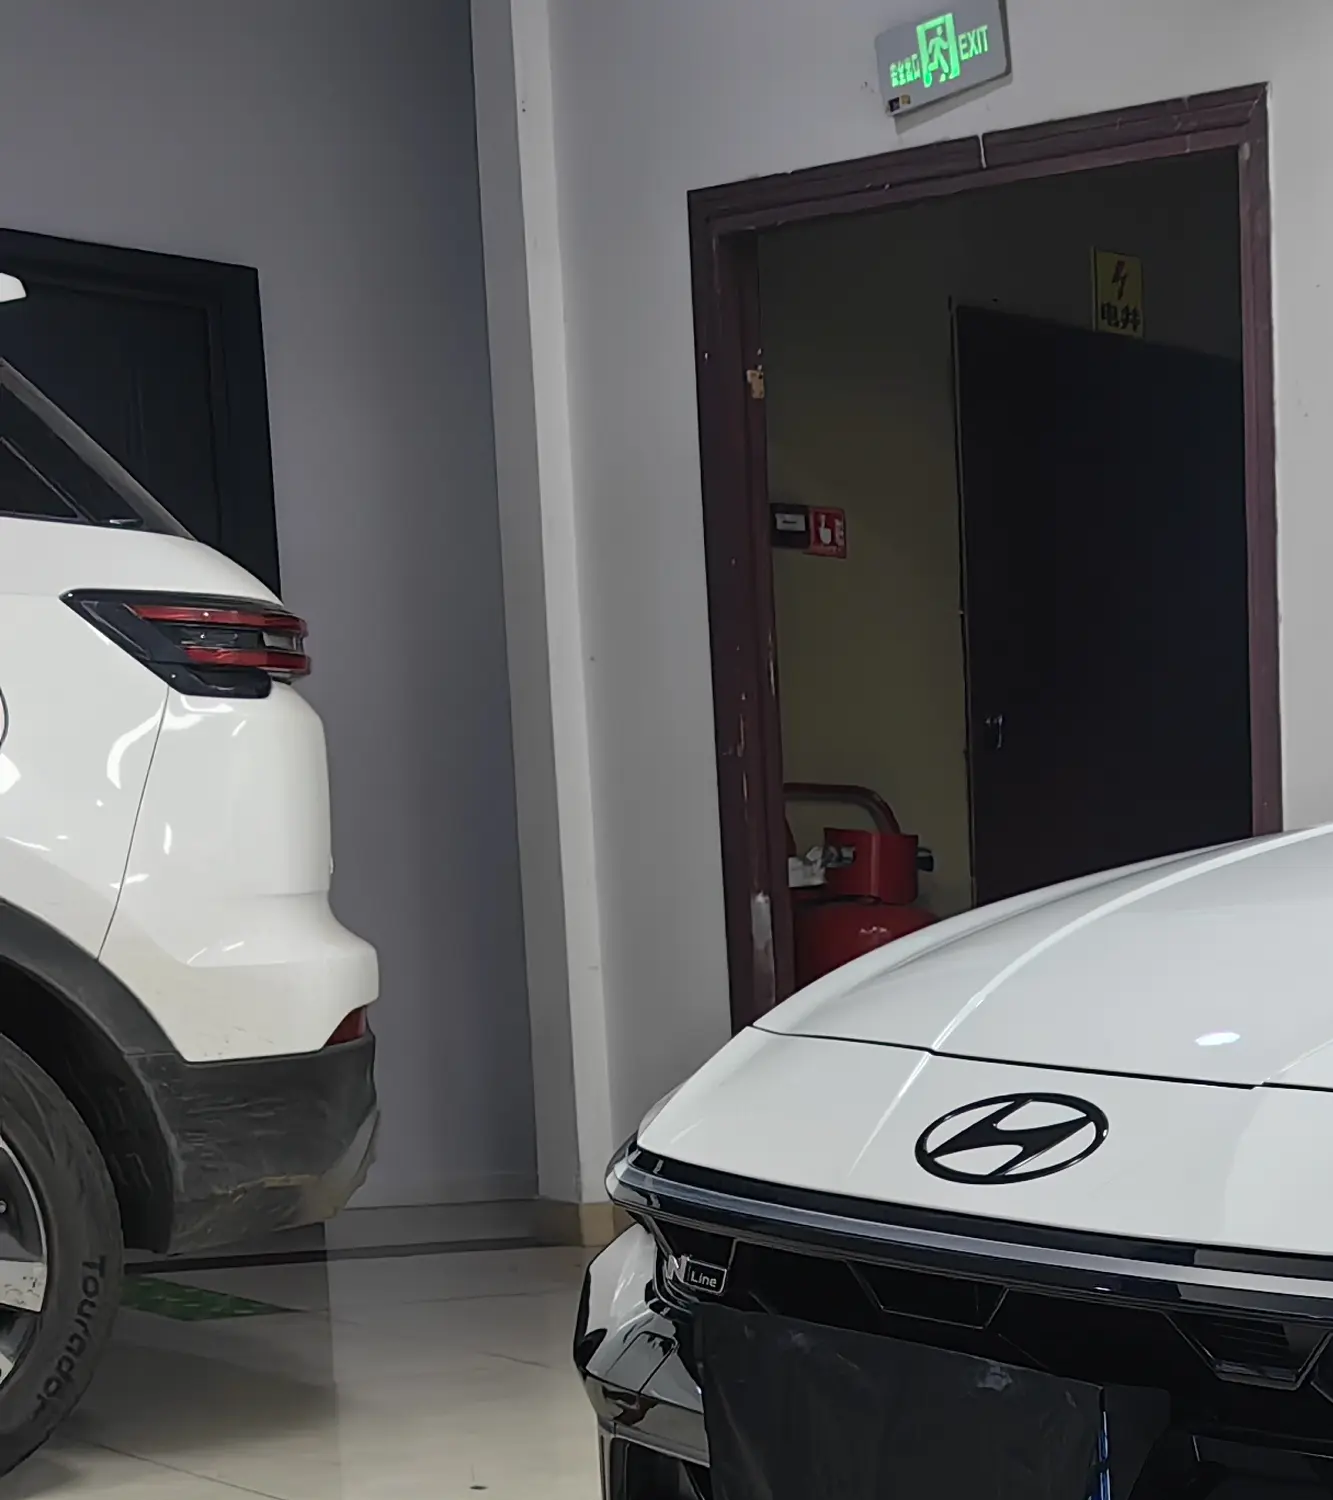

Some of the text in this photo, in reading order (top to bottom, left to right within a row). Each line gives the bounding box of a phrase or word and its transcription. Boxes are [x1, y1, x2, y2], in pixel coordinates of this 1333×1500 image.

[958, 25, 989, 61] EXIT
[1101, 302, 1141, 332] 电井
[690, 1271, 717, 1288] Line
[30, 1255, 106, 1422] Tourador
